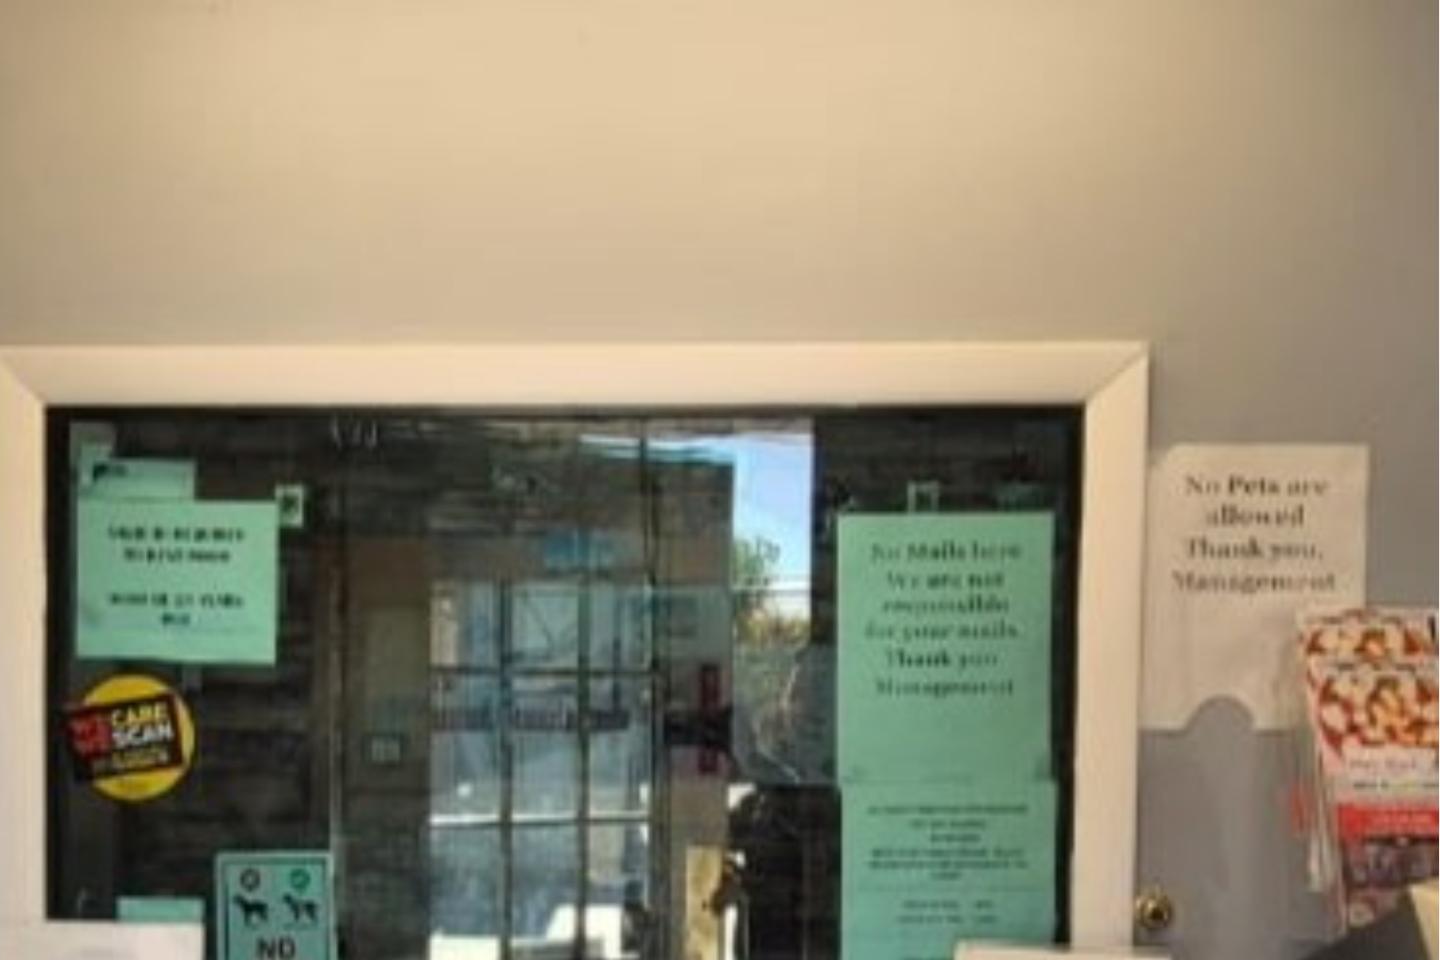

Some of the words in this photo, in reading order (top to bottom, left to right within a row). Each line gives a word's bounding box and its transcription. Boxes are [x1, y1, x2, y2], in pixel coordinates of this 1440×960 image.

[1185, 475, 1220, 495] No
[1228, 473, 1280, 496] Pets
[1207, 504, 1305, 527] allowed
[1187, 536, 1263, 559] Thank
[257, 937, 296, 960] NO
